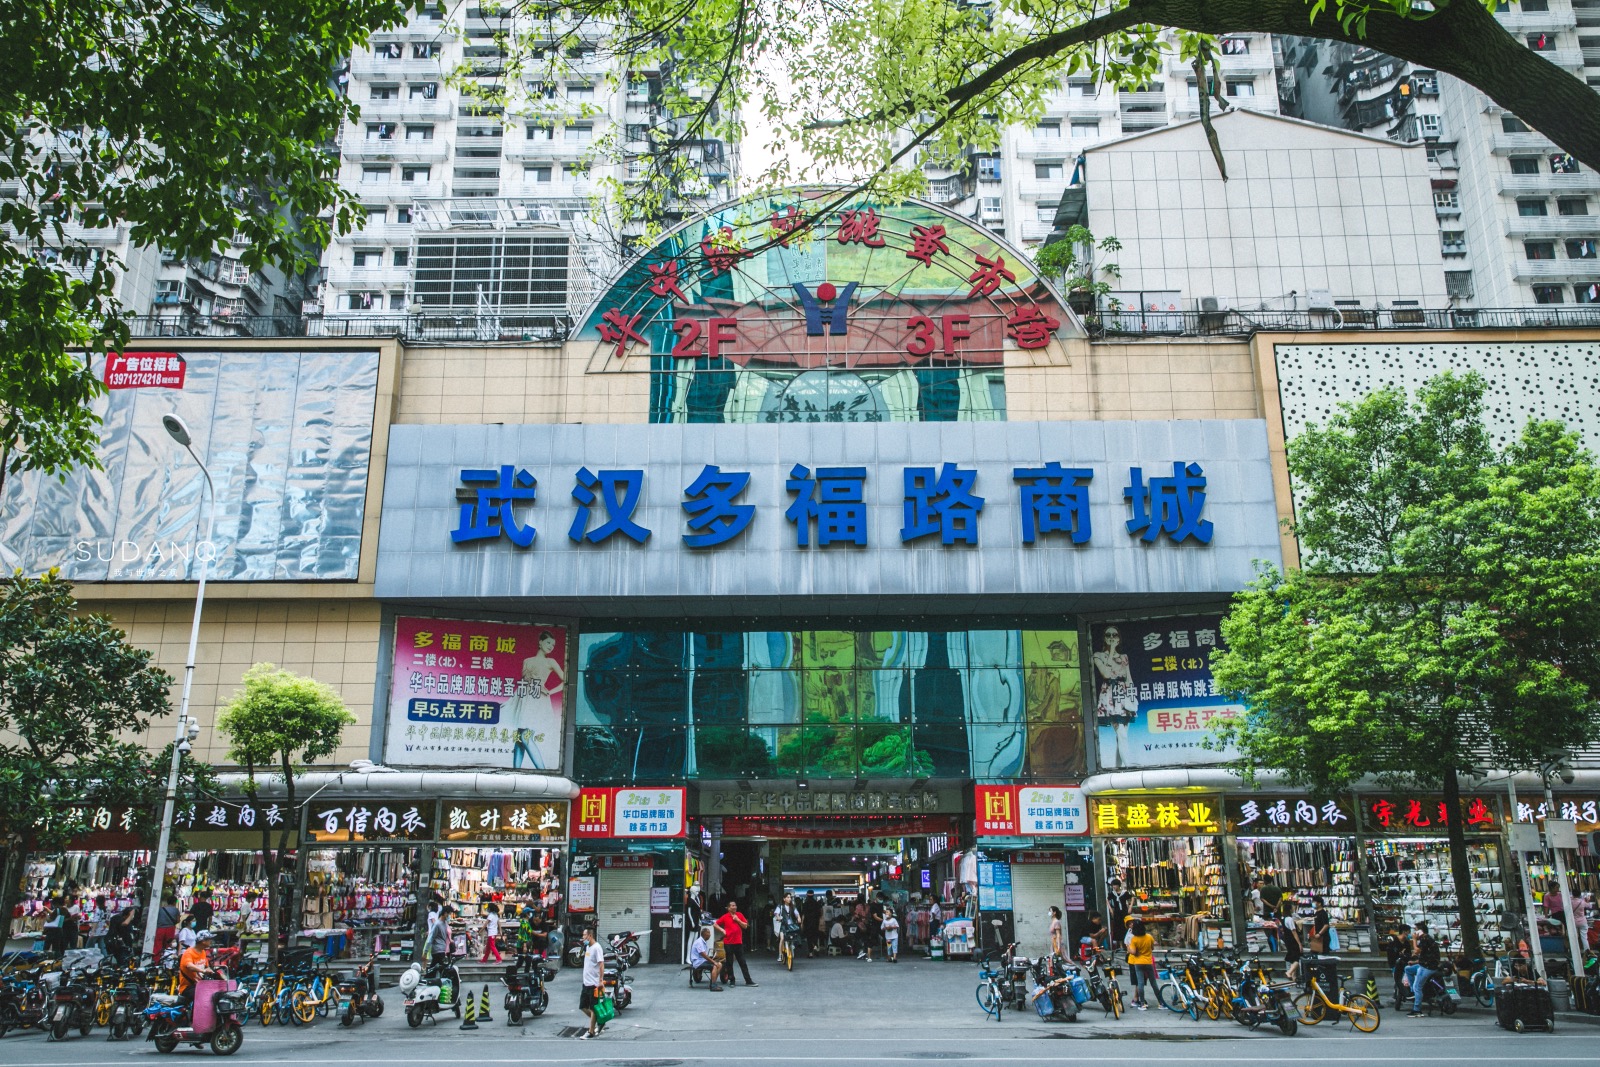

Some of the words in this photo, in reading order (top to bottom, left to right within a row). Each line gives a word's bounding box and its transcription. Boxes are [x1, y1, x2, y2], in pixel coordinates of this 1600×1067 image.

[672, 318, 737, 358] 2F
[906, 314, 971, 356] 3F
[112, 357, 181, 371] 广告位招租
[109, 373, 162, 385] 13971274218
[450, 462, 1215, 548] 武汉多福路商城
[413, 631, 516, 654] 多福商城
[1142, 628, 1231, 651] 多福商
[409, 671, 542, 699] 华中品牌服饰跳蚤市场
[1112, 678, 1248, 703] 华中品牌服饰跳蚤
[411, 701, 495, 720] 早5点开市
[658, 793, 671, 805] 3F
[1061, 791, 1075, 803] 3F
[317, 806, 426, 833] 百信内衣
[449, 807, 561, 831] 凯升袜业
[623, 809, 675, 819] 华中品牌服饰
[1027, 807, 1080, 817] 华中品牌服饰
[1098, 802, 1213, 829] 昌盛袜业
[1236, 799, 1348, 826] 多福内衣
[629, 822, 668, 832] 跳蚤市场
[984, 821, 1013, 829] 电梯直达
[1034, 820, 1074, 830] 跳蚤市场
